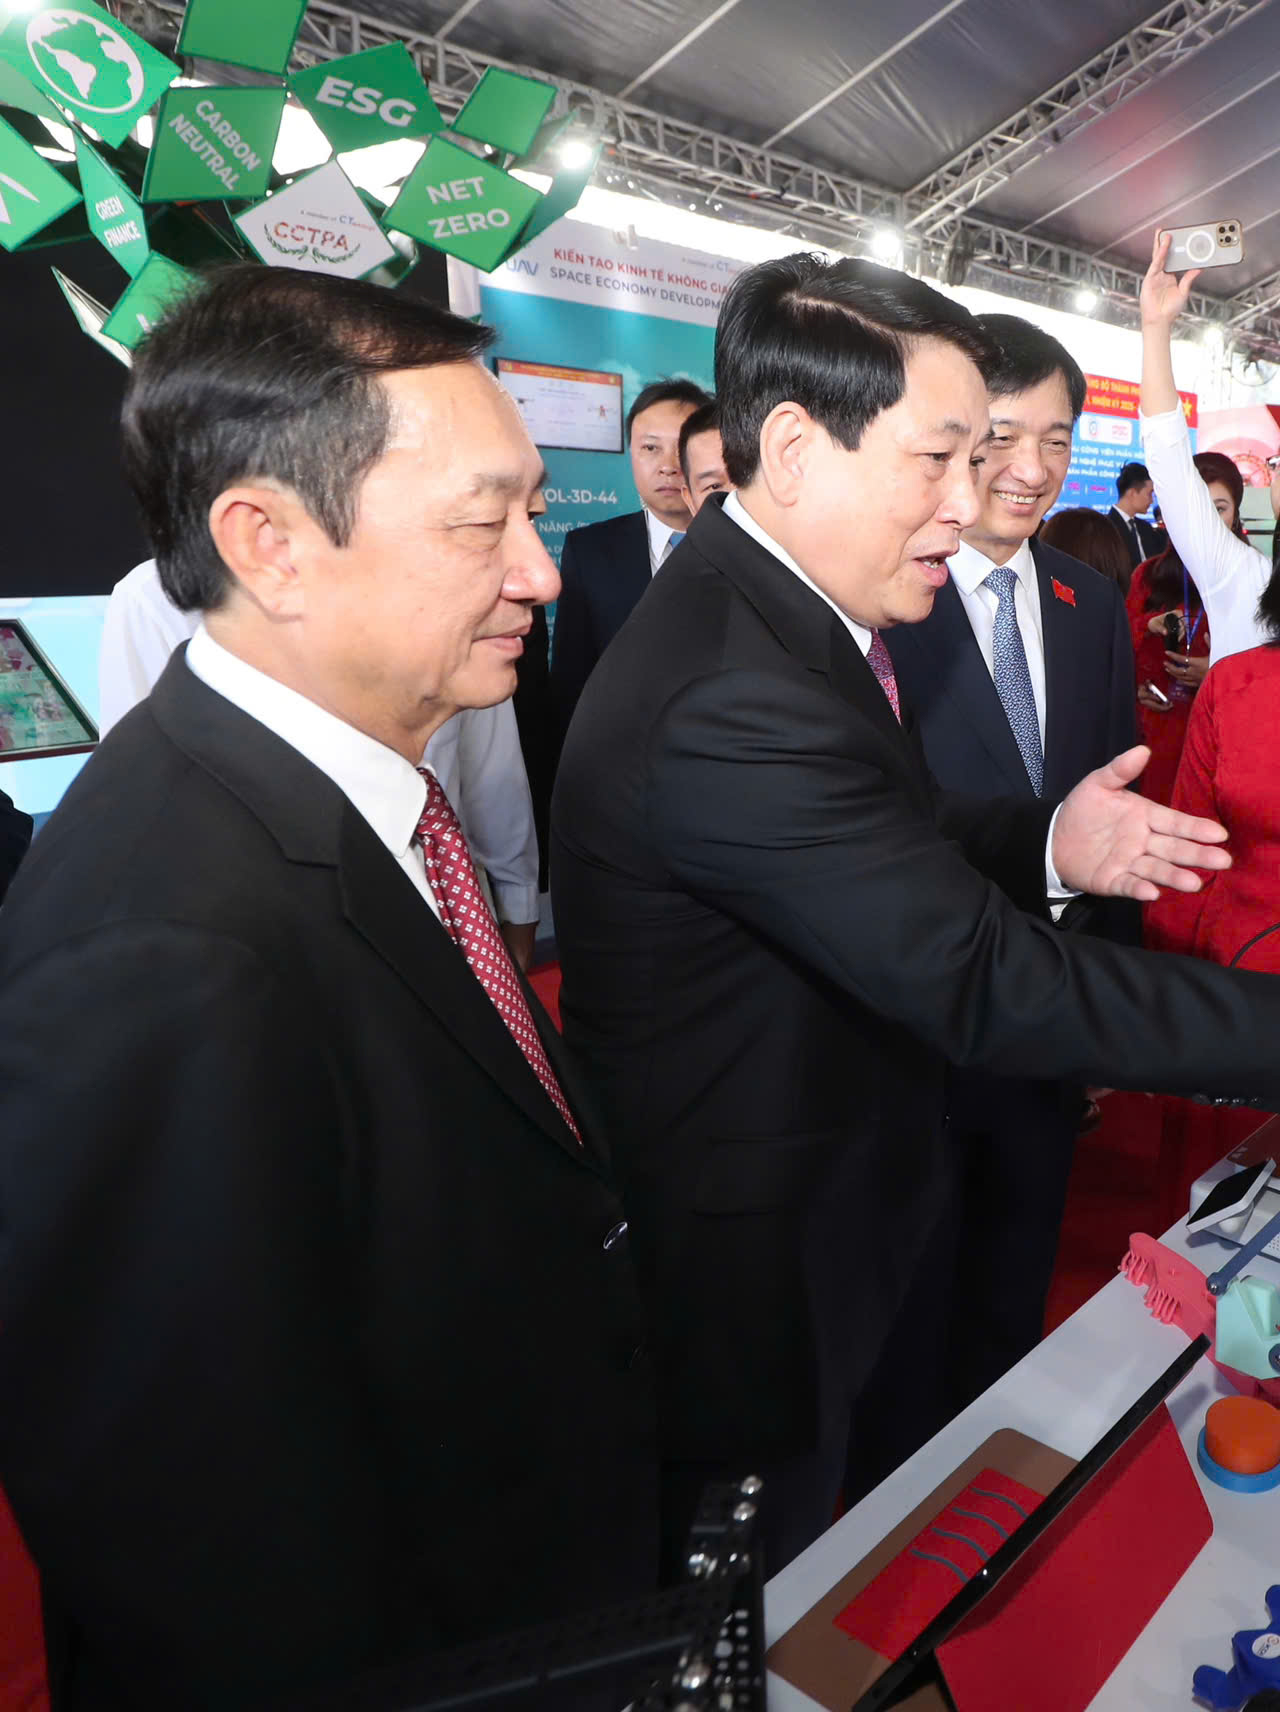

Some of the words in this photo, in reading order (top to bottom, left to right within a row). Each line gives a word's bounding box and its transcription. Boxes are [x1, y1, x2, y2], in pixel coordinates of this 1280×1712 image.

[315, 76, 417, 127] ESG
[196, 100, 261, 171] CARBON
[169, 113, 240, 191] NEUTRAL
[426, 176, 484, 204] NET
[95, 195, 125, 220] GREEN
[104, 221, 142, 248] FINANCE
[274, 221, 349, 251] CCTPA
[428, 208, 510, 239] ZERO
[550, 266, 592, 285] SPACE
[596, 276, 657, 297] ECONOMY
[660, 288, 721, 309] DEVELOPM
[617, 263, 648, 278] KINH
[667, 273, 708, 290] KHÔNG
[710, 282, 731, 295] GIA
[542, 488, 618, 504] OL-3D-44
